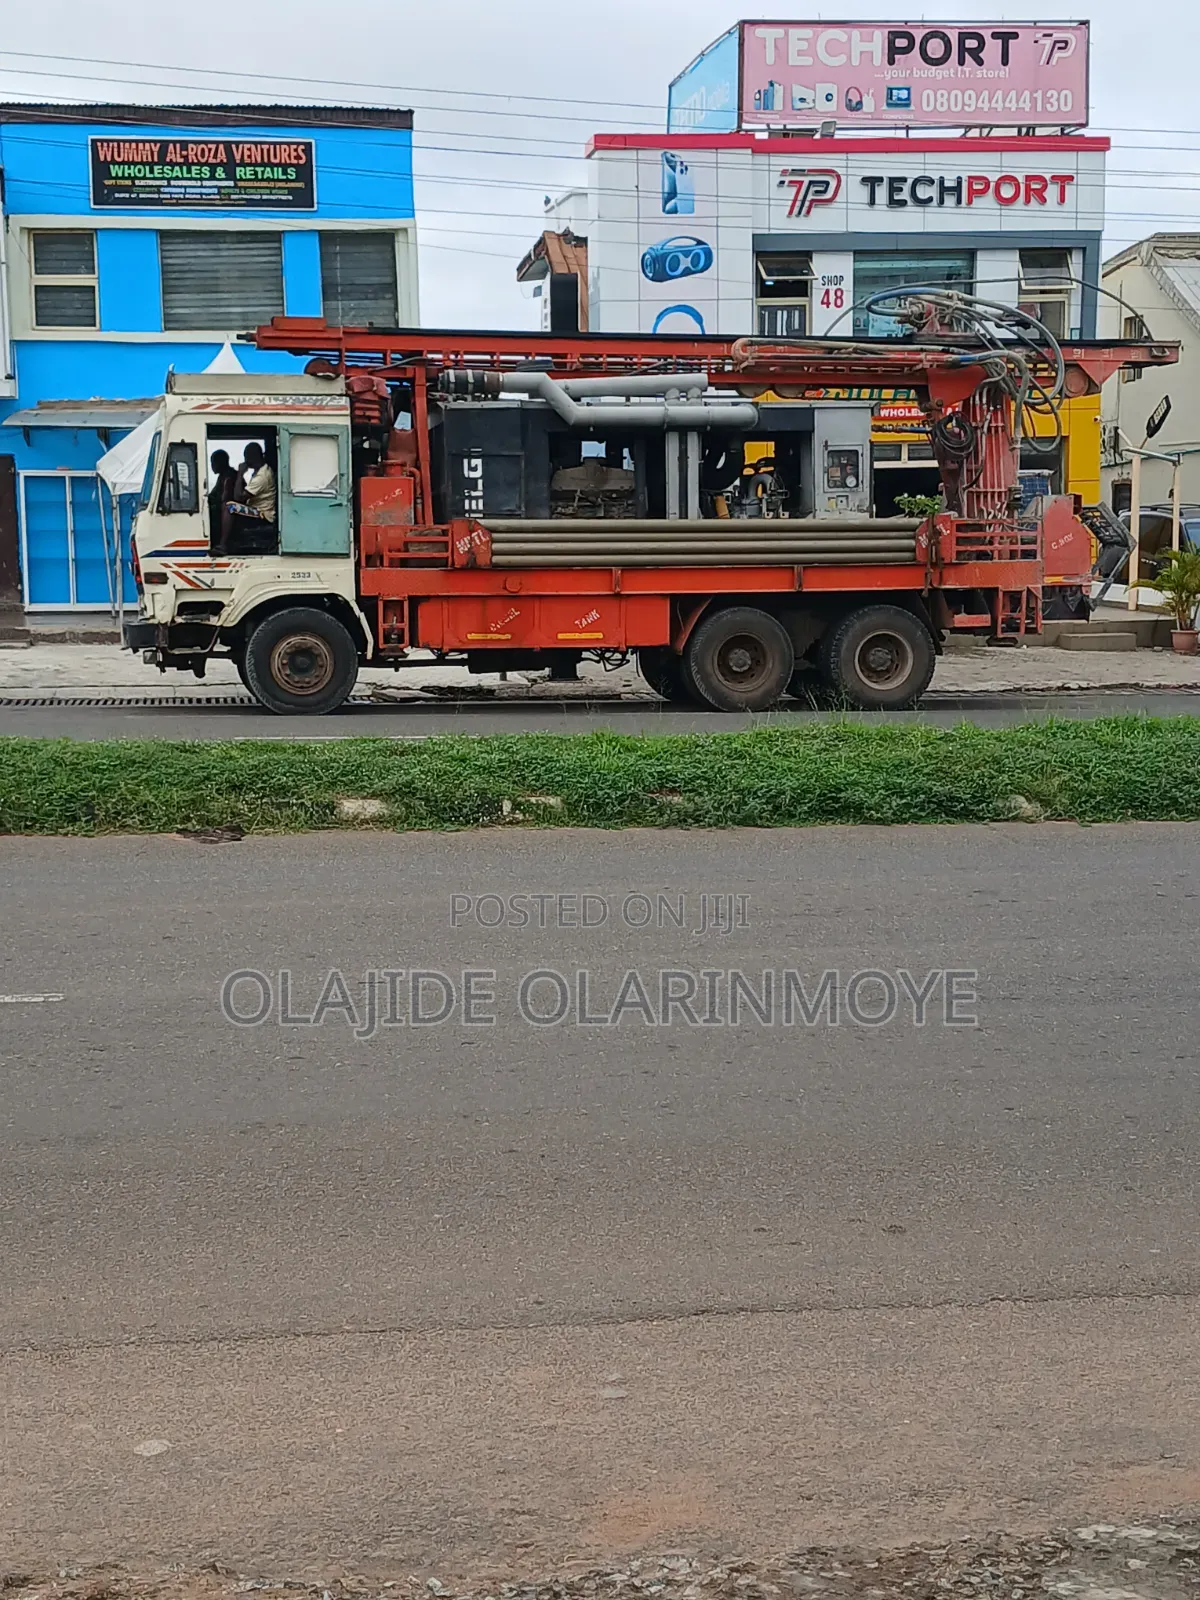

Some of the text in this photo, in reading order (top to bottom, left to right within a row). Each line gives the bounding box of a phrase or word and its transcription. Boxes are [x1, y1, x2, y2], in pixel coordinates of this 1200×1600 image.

[754, 28, 1020, 67] TECHPORT
[913, 67, 955, 80] budget
[921, 89, 1073, 112] 08094444130
[97, 141, 306, 164] WUMMY AL-ROZA VENTURES
[109, 164, 297, 180] WHOLESALES & RETAILS
[860, 175, 1075, 208] TECHPORT
[821, 275, 844, 286] SHOP
[820, 288, 844, 309] 48
[574, 609, 600, 629] TANK
